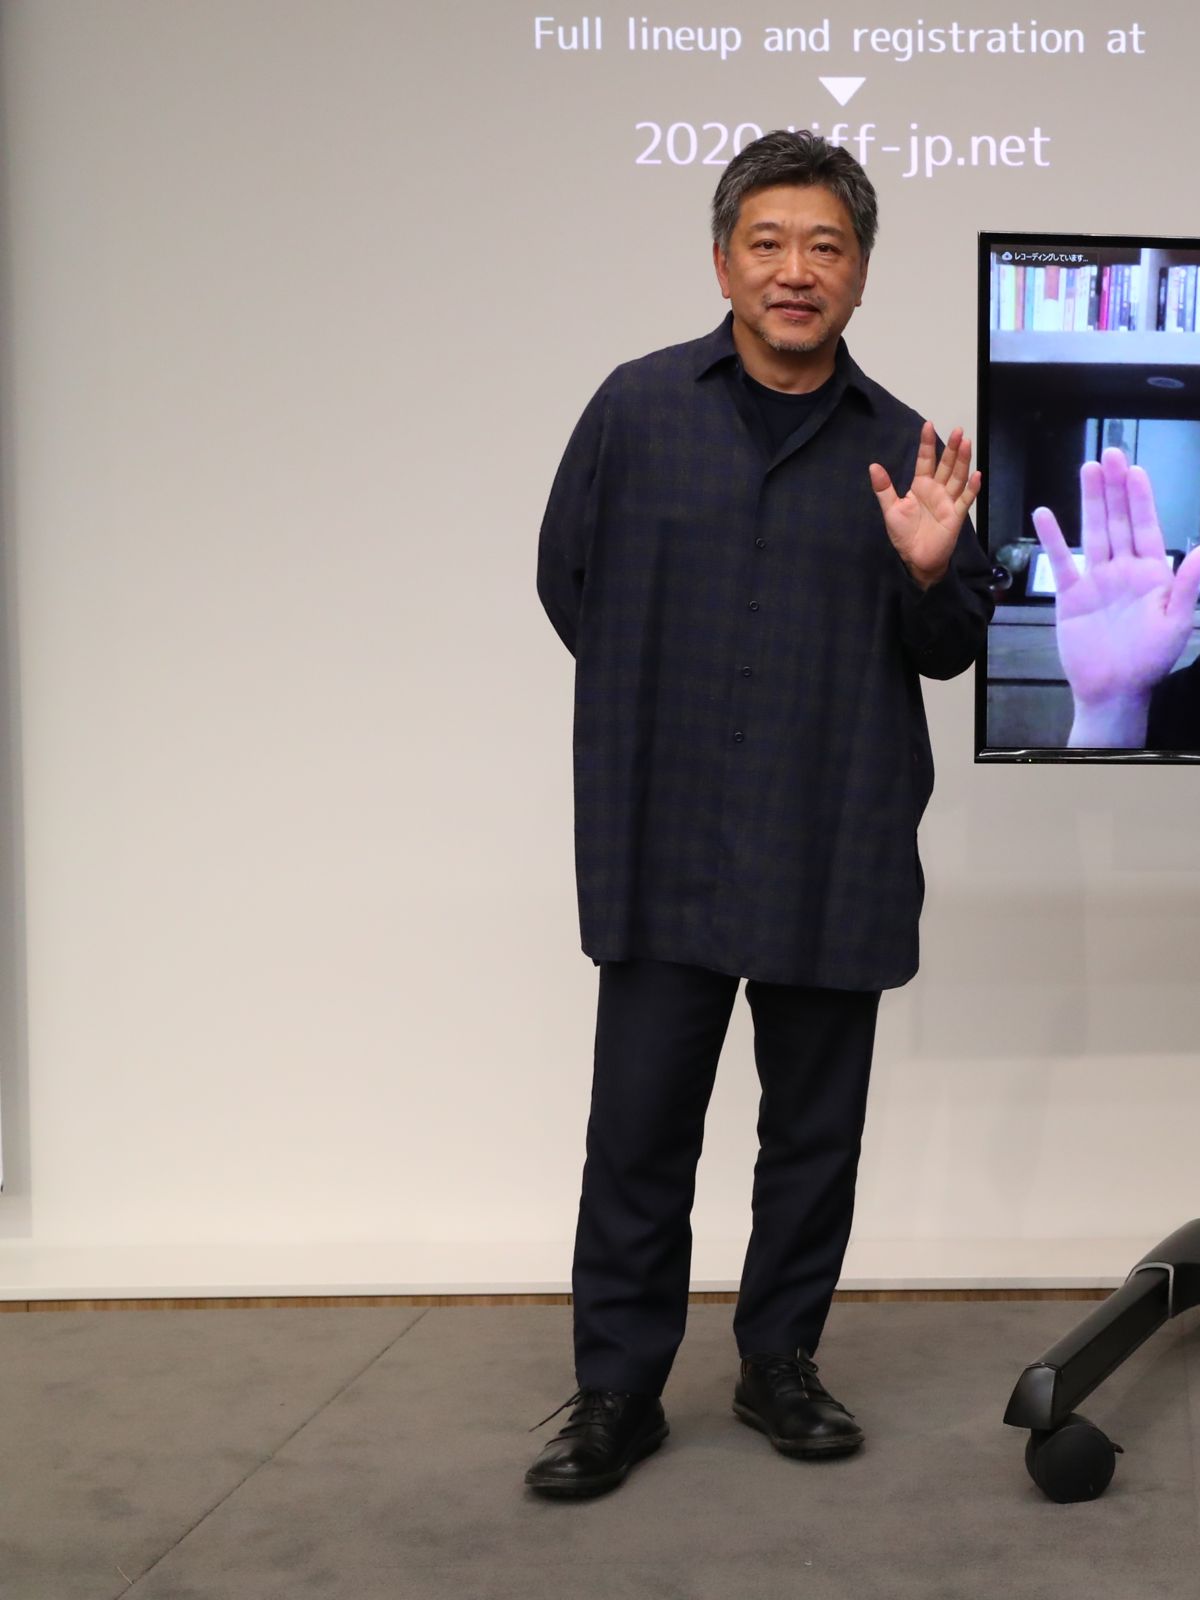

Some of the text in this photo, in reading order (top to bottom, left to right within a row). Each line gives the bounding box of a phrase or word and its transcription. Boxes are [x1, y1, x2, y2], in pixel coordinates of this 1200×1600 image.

[534, 16, 1146, 62] Full lineup and registration at
